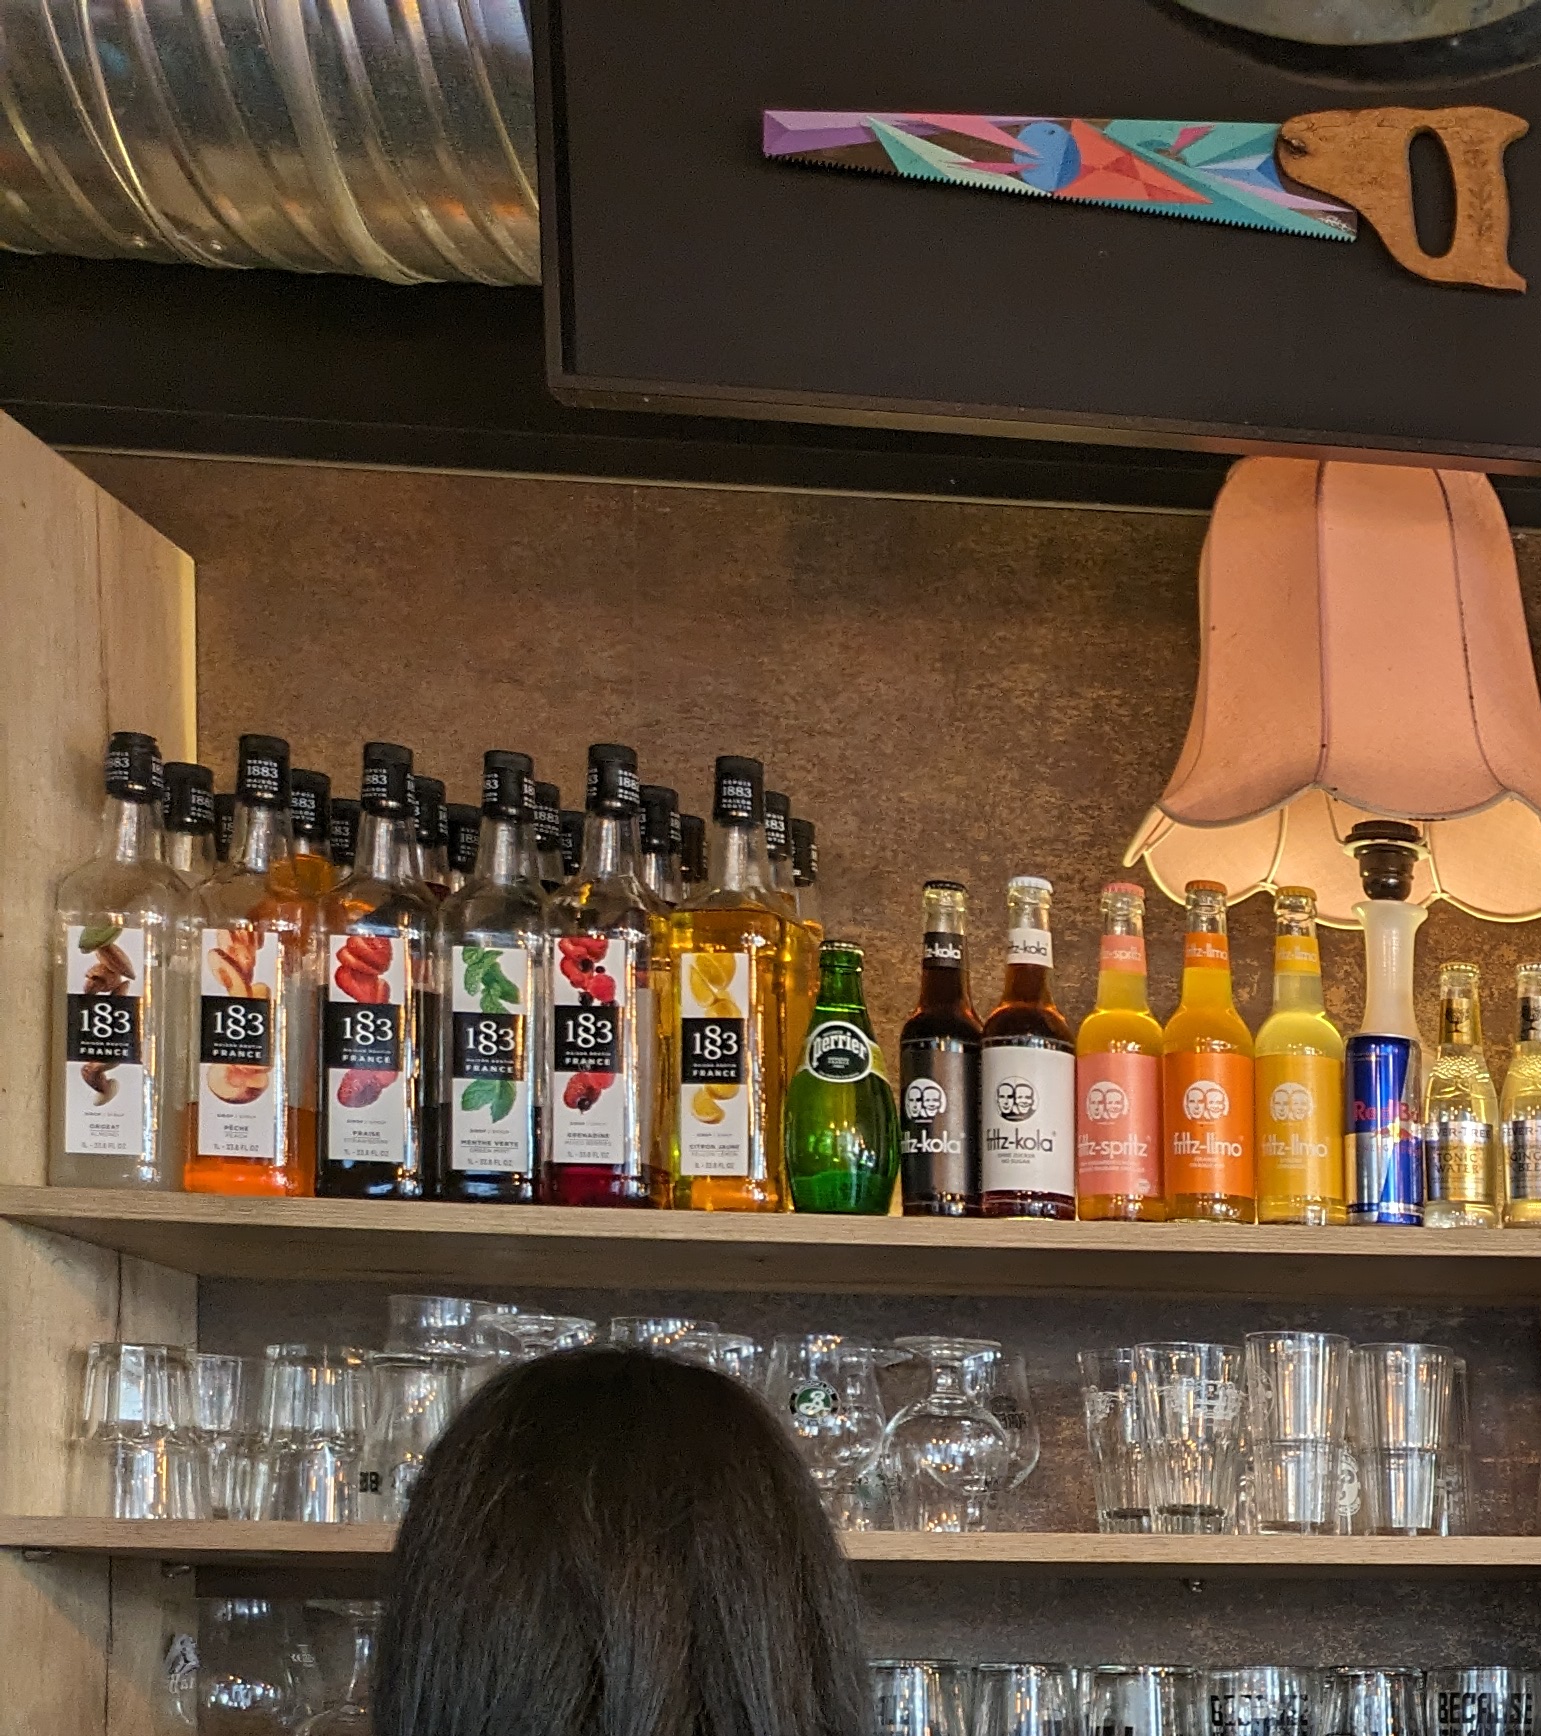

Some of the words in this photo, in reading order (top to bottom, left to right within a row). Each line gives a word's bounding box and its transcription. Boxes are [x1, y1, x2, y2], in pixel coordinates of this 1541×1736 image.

[247, 766, 279, 779] 1883
[722, 785, 752, 798] 1883
[80, 1048, 129, 1057] FRANCE
[213, 1049, 262, 1059] FRANCE
[342, 1055, 390, 1064] FRANCE
[565, 1057, 611, 1066] FRANCE
[465, 1064, 514, 1074] FRANCE
[692, 1069, 736, 1077] FRANCE
[987, 1129, 1053, 1152] fritz-kola
[1174, 1132, 1242, 1157] fritz-limo
[1437, 1152, 1477, 1163] TONIC
[1435, 1163, 1479, 1175] WATER
